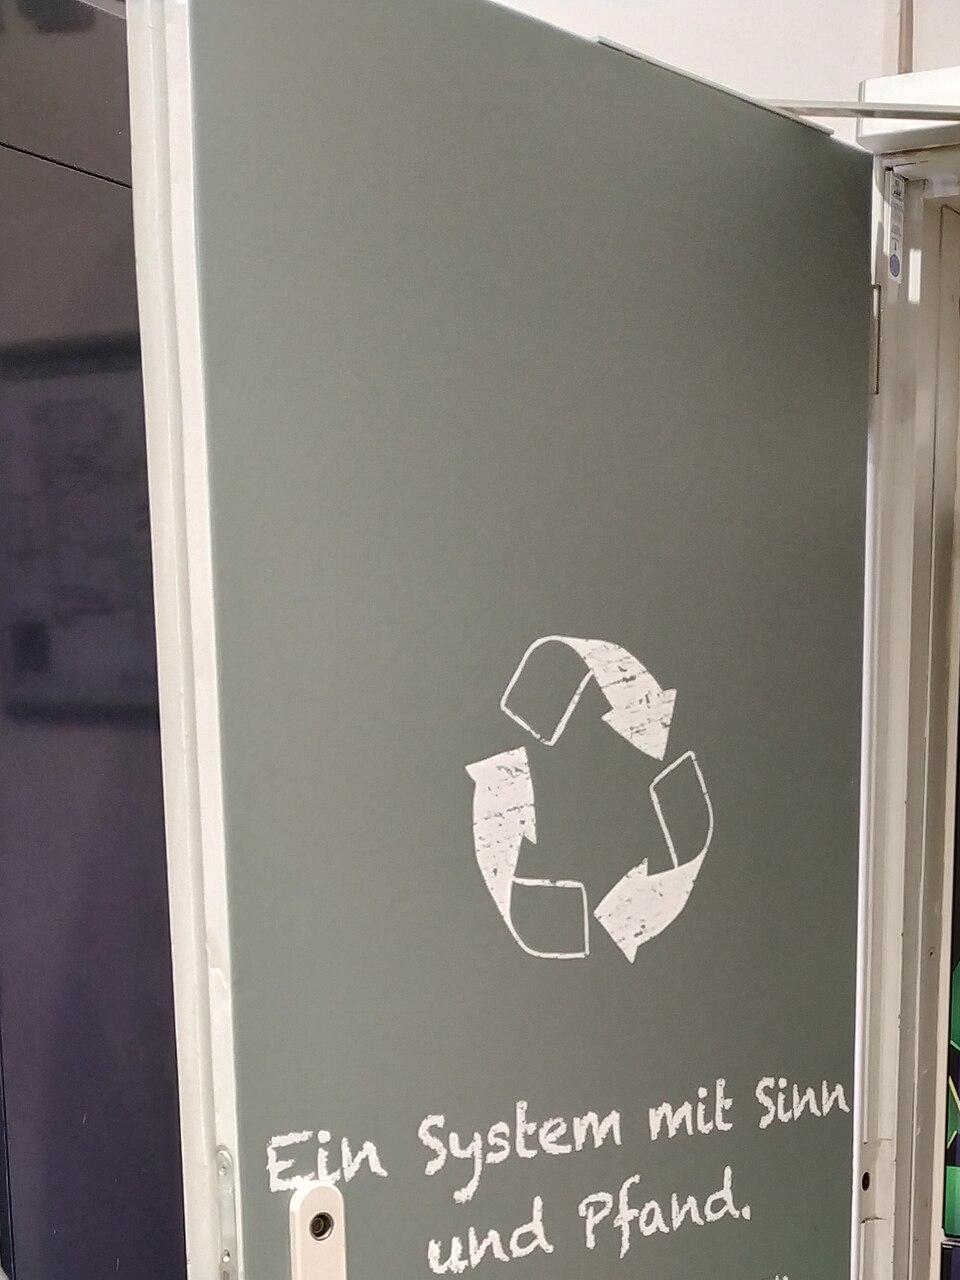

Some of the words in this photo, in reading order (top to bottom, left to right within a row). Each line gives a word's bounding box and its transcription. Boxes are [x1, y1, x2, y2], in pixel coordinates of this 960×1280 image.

[265, 1129, 388, 1193] Ein
[418, 1100, 622, 1204] System
[649, 1078, 733, 1140] mit
[756, 1077, 850, 1128] Sinn
[427, 1196, 554, 1274] und
[578, 1166, 751, 1258] Pfand.
